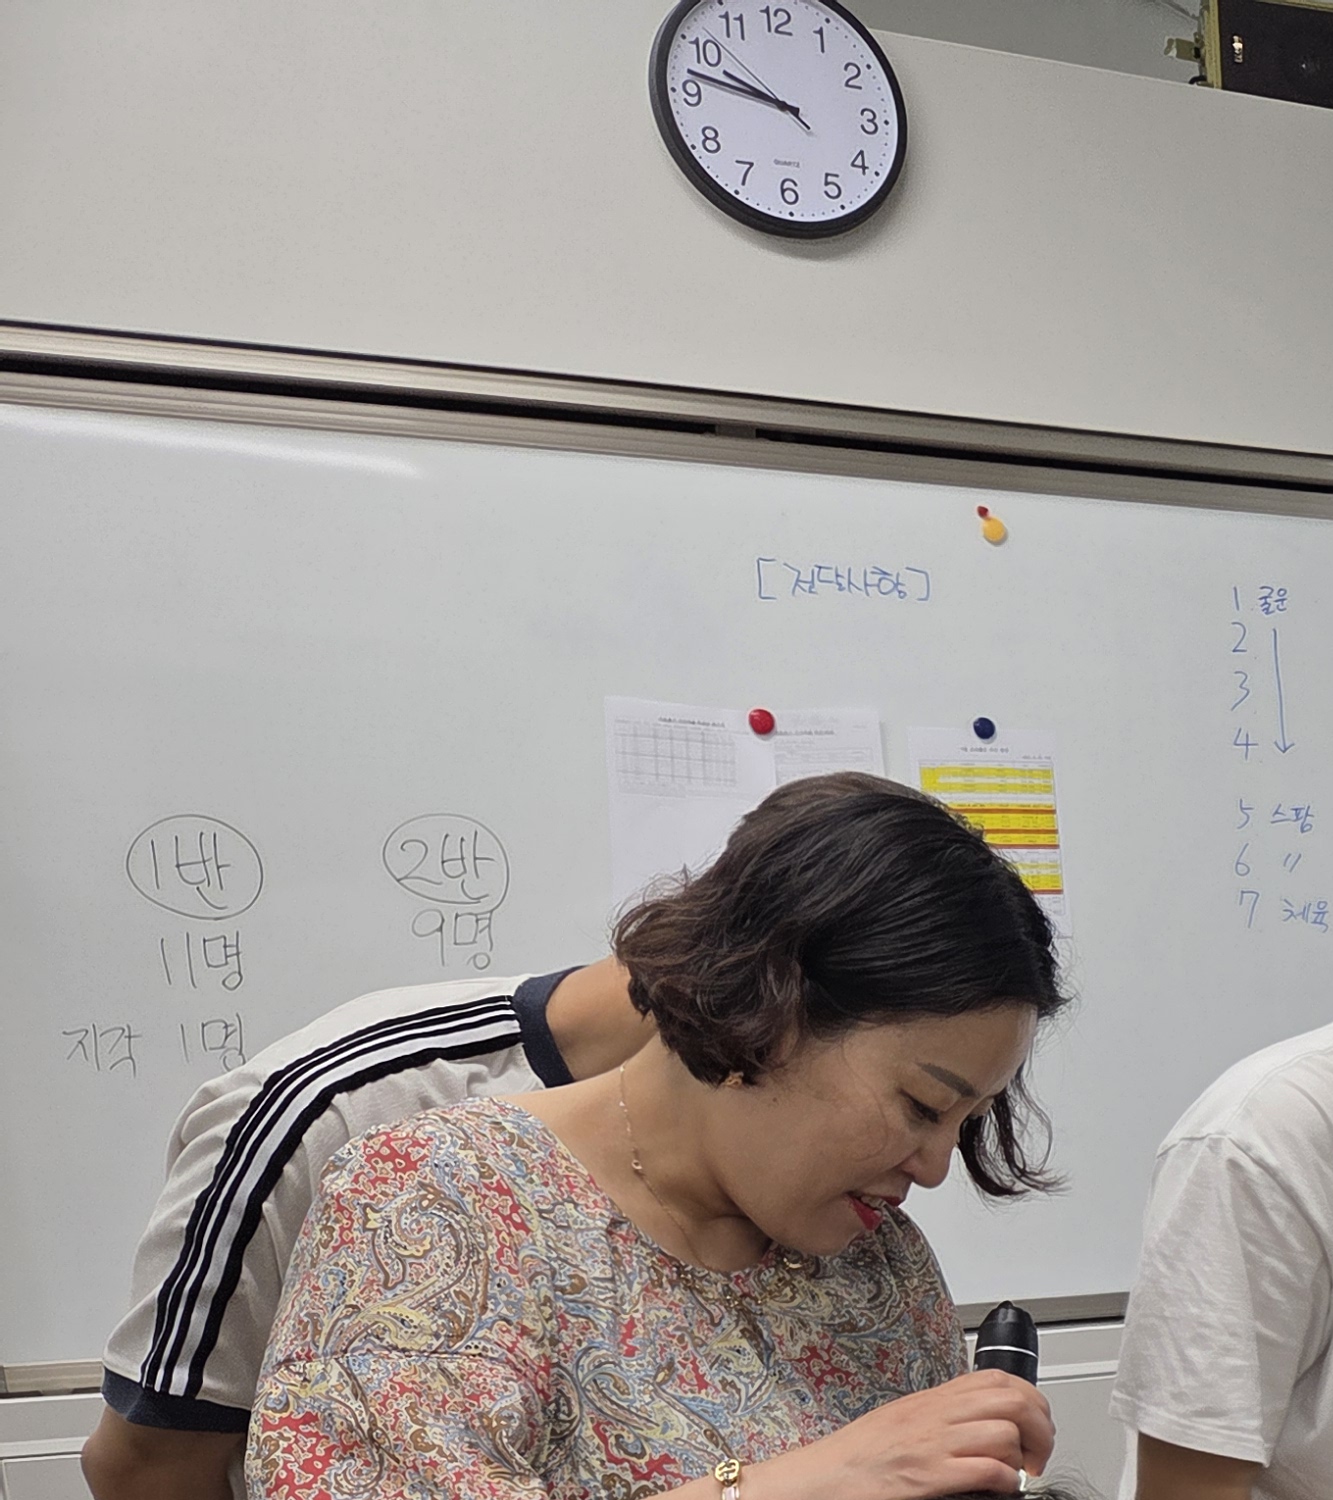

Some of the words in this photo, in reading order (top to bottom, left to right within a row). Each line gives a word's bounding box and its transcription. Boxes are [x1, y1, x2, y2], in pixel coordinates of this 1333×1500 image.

[718, 10, 746, 42] 11
[759, 5, 794, 37] 12
[688, 36, 722, 68] 10
[812, 26, 826, 54] 1
[843, 62, 863, 91] 2
[681, 78, 703, 108] 9
[860, 107, 879, 136] 3
[701, 125, 722, 155] 8
[734, 159, 755, 187] 7
[850, 149, 870, 176] 4
[779, 177, 800, 206] 6
[823, 172, 843, 200] 5
[1233, 586, 1240, 611] 1
[1231, 621, 1248, 653] 2
[1230, 670, 1251, 712] 3
[1232, 727, 1260, 761] 4
[1236, 798, 1255, 830] 5
[149, 831, 232, 911] 1반
[396, 829, 498, 902] 2반
[1234, 842, 1251, 877] 6
[1239, 889, 1260, 929] 7
[1282, 898, 1329, 934] 체육
[410, 908, 495, 970] 9명
[159, 930, 244, 991] 11명
[62, 1022, 142, 1078] 지각
